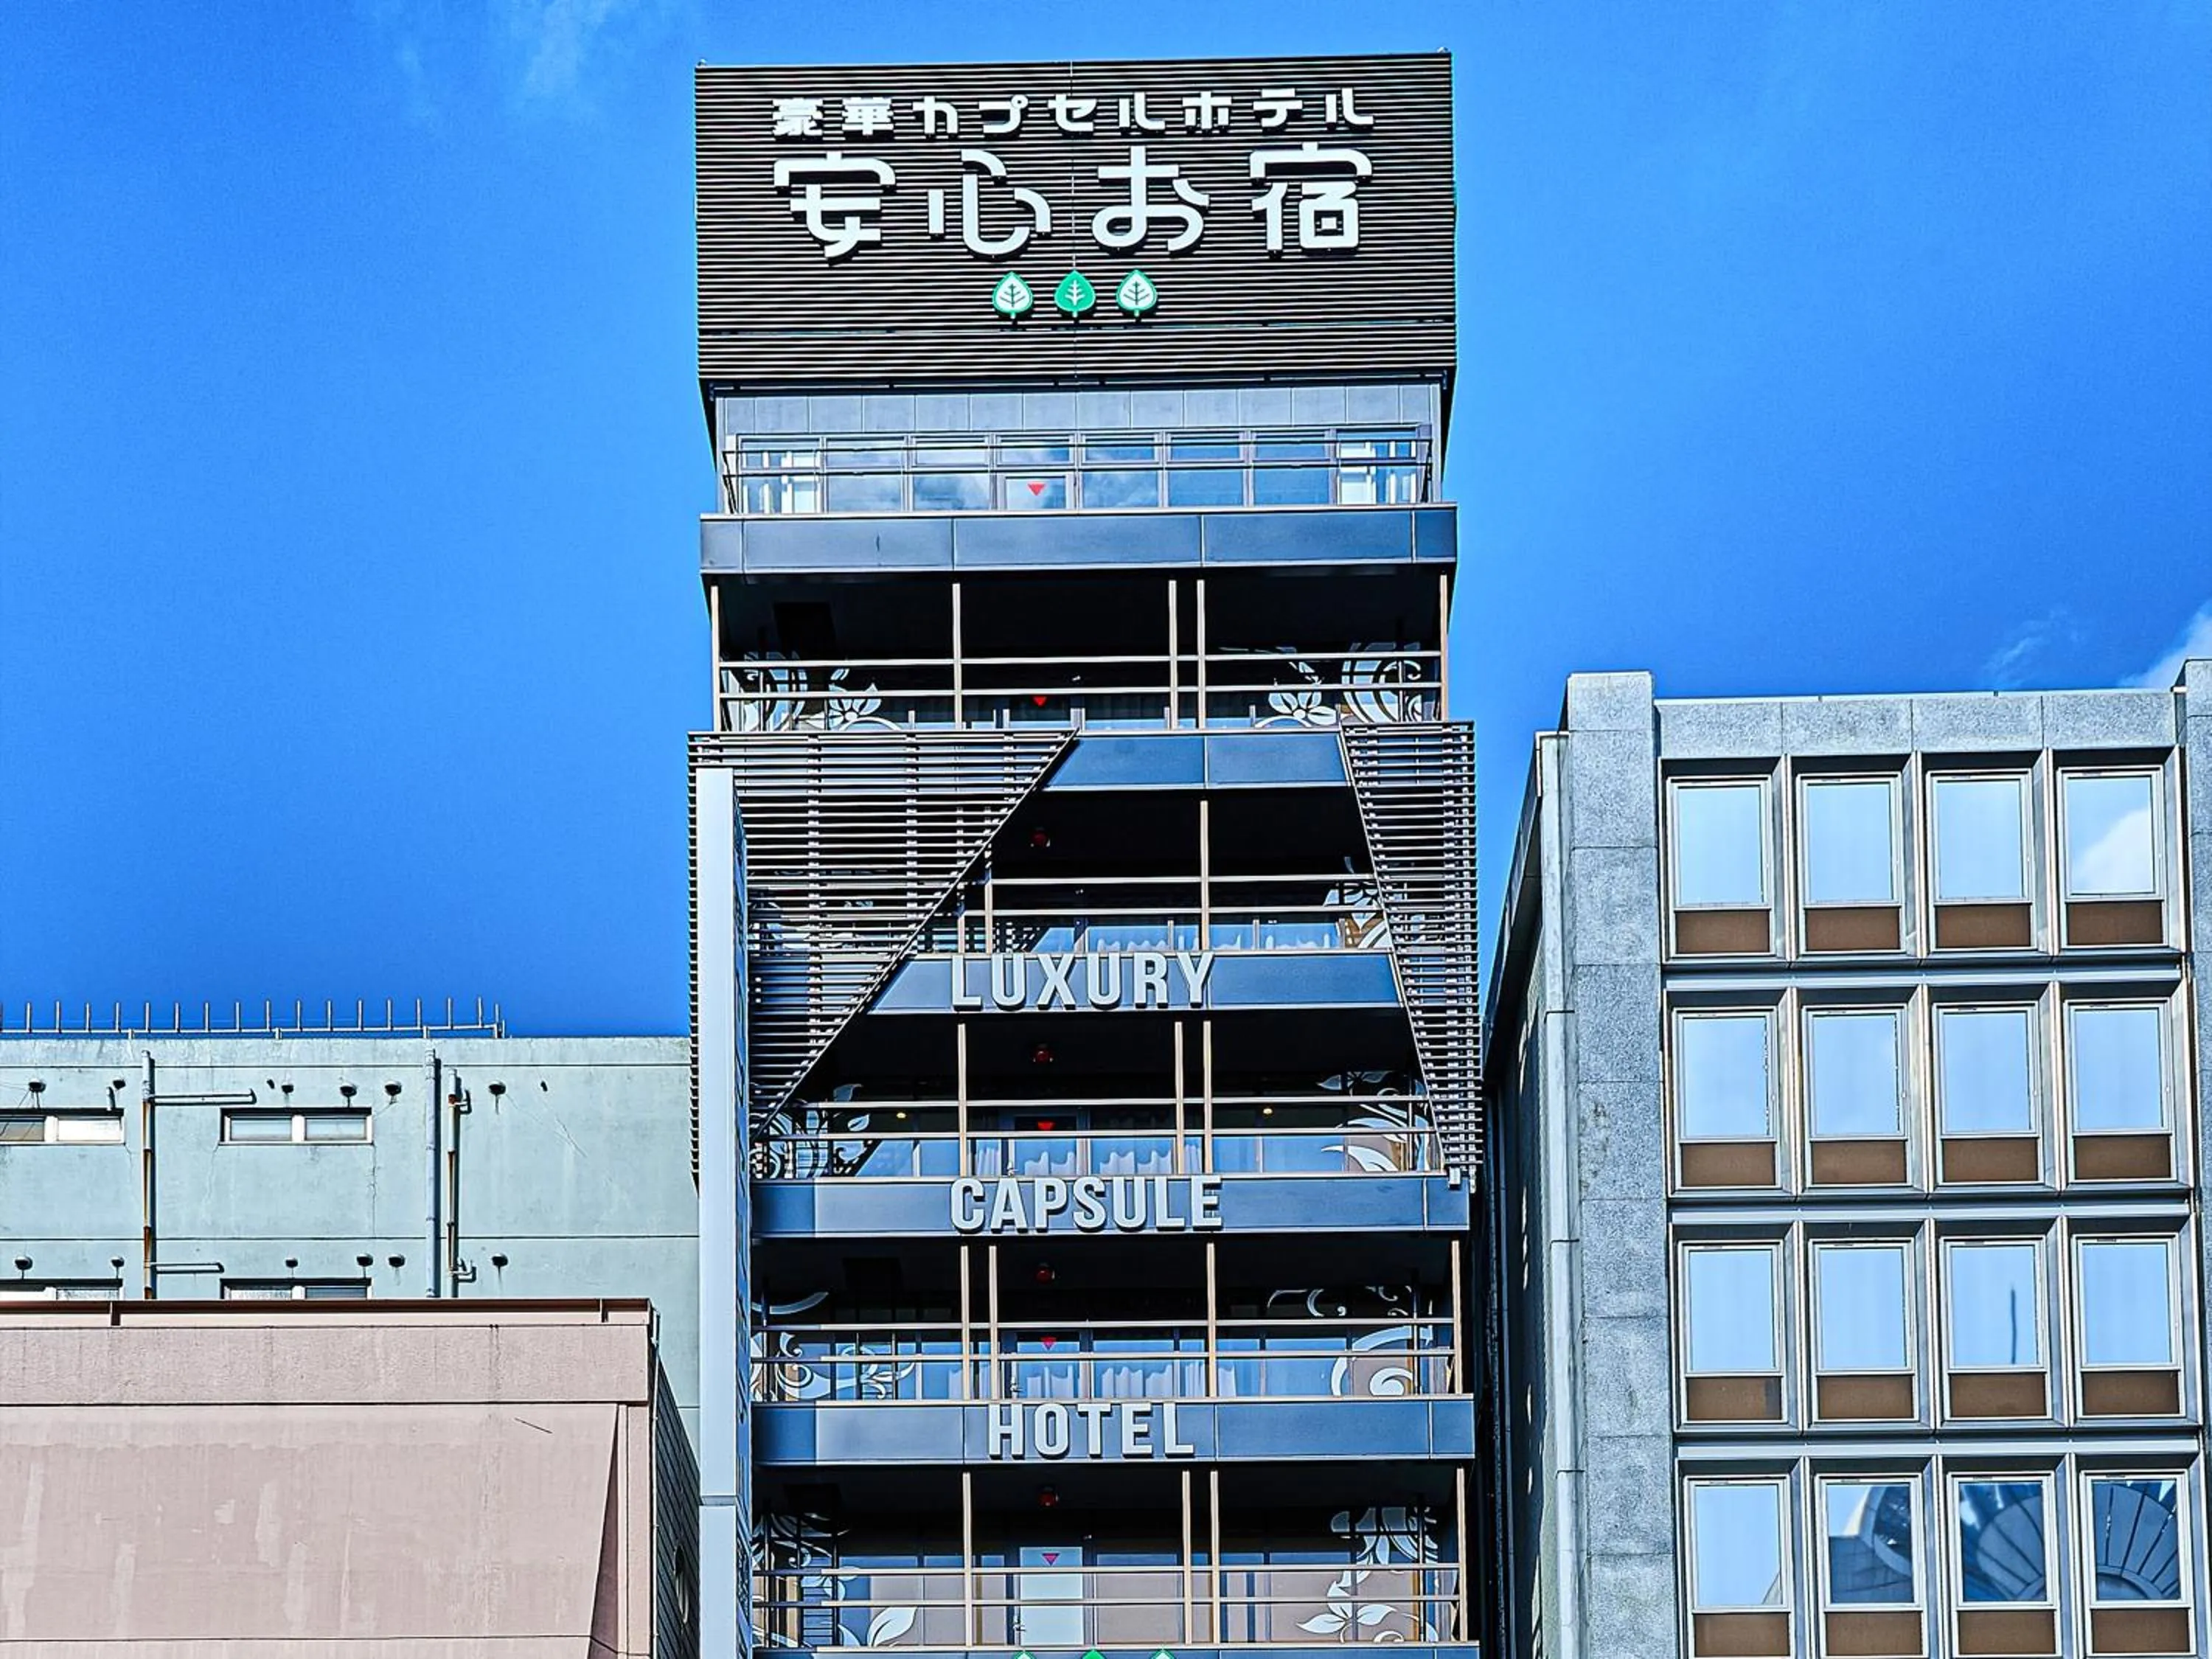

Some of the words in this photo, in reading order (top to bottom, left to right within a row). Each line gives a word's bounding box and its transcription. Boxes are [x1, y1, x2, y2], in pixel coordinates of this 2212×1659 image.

[773, 88, 1374, 136] 豪華カプセルホテル
[773, 143, 1372, 258] 安心お宿
[951, 952, 1215, 1008] LUXURY
[951, 1175, 1222, 1232] CAPSULE
[989, 1402, 1194, 1457] HOTEL
